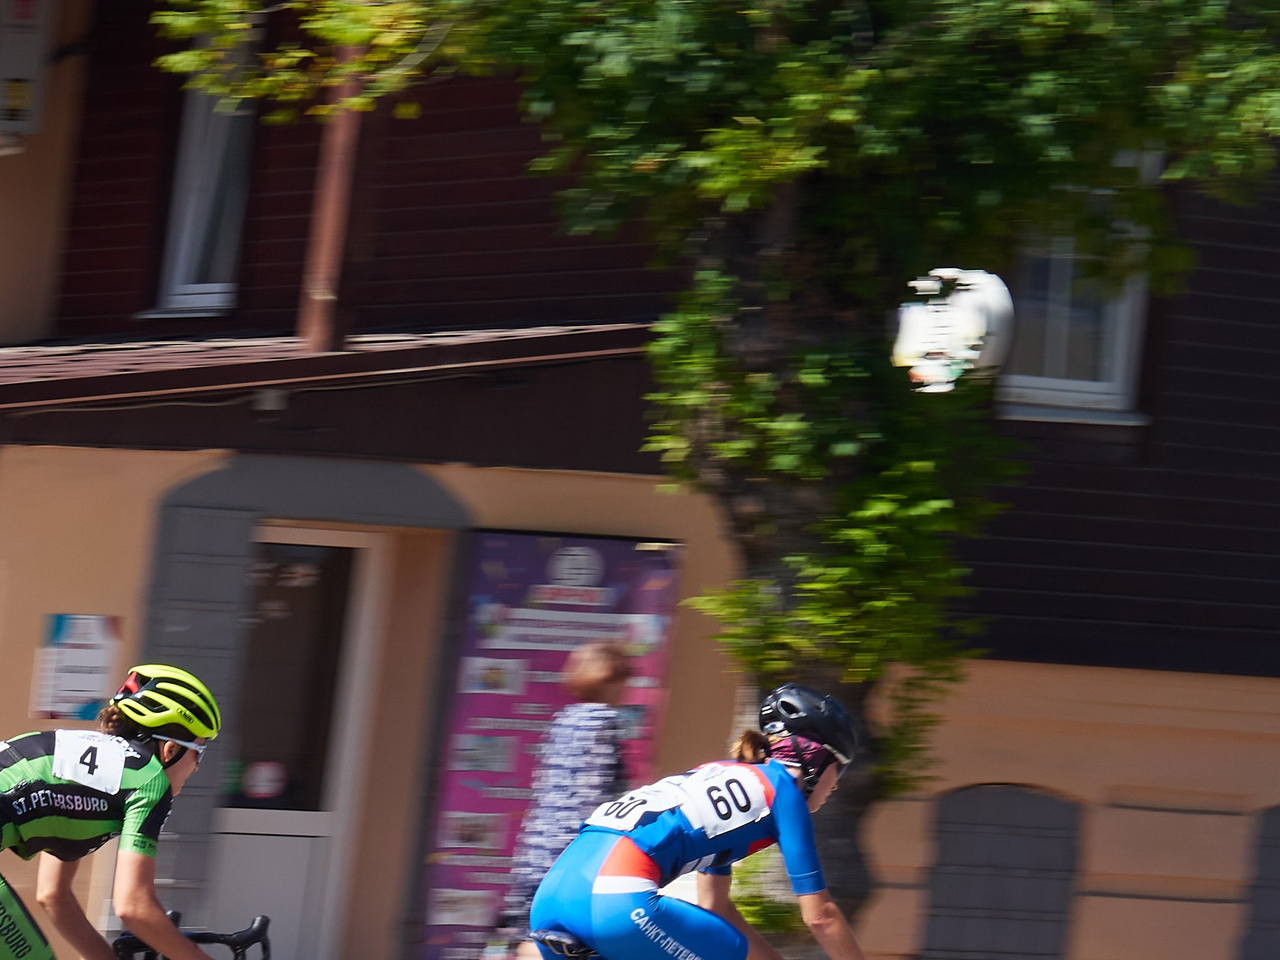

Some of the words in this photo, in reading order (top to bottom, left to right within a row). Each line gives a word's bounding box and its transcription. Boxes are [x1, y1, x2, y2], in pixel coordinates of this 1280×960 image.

[78, 745, 99, 776] 4
[11, 789, 109, 816] ST.PETERSBURG
[603, 796, 648, 819] 60
[706, 778, 751, 821] 60
